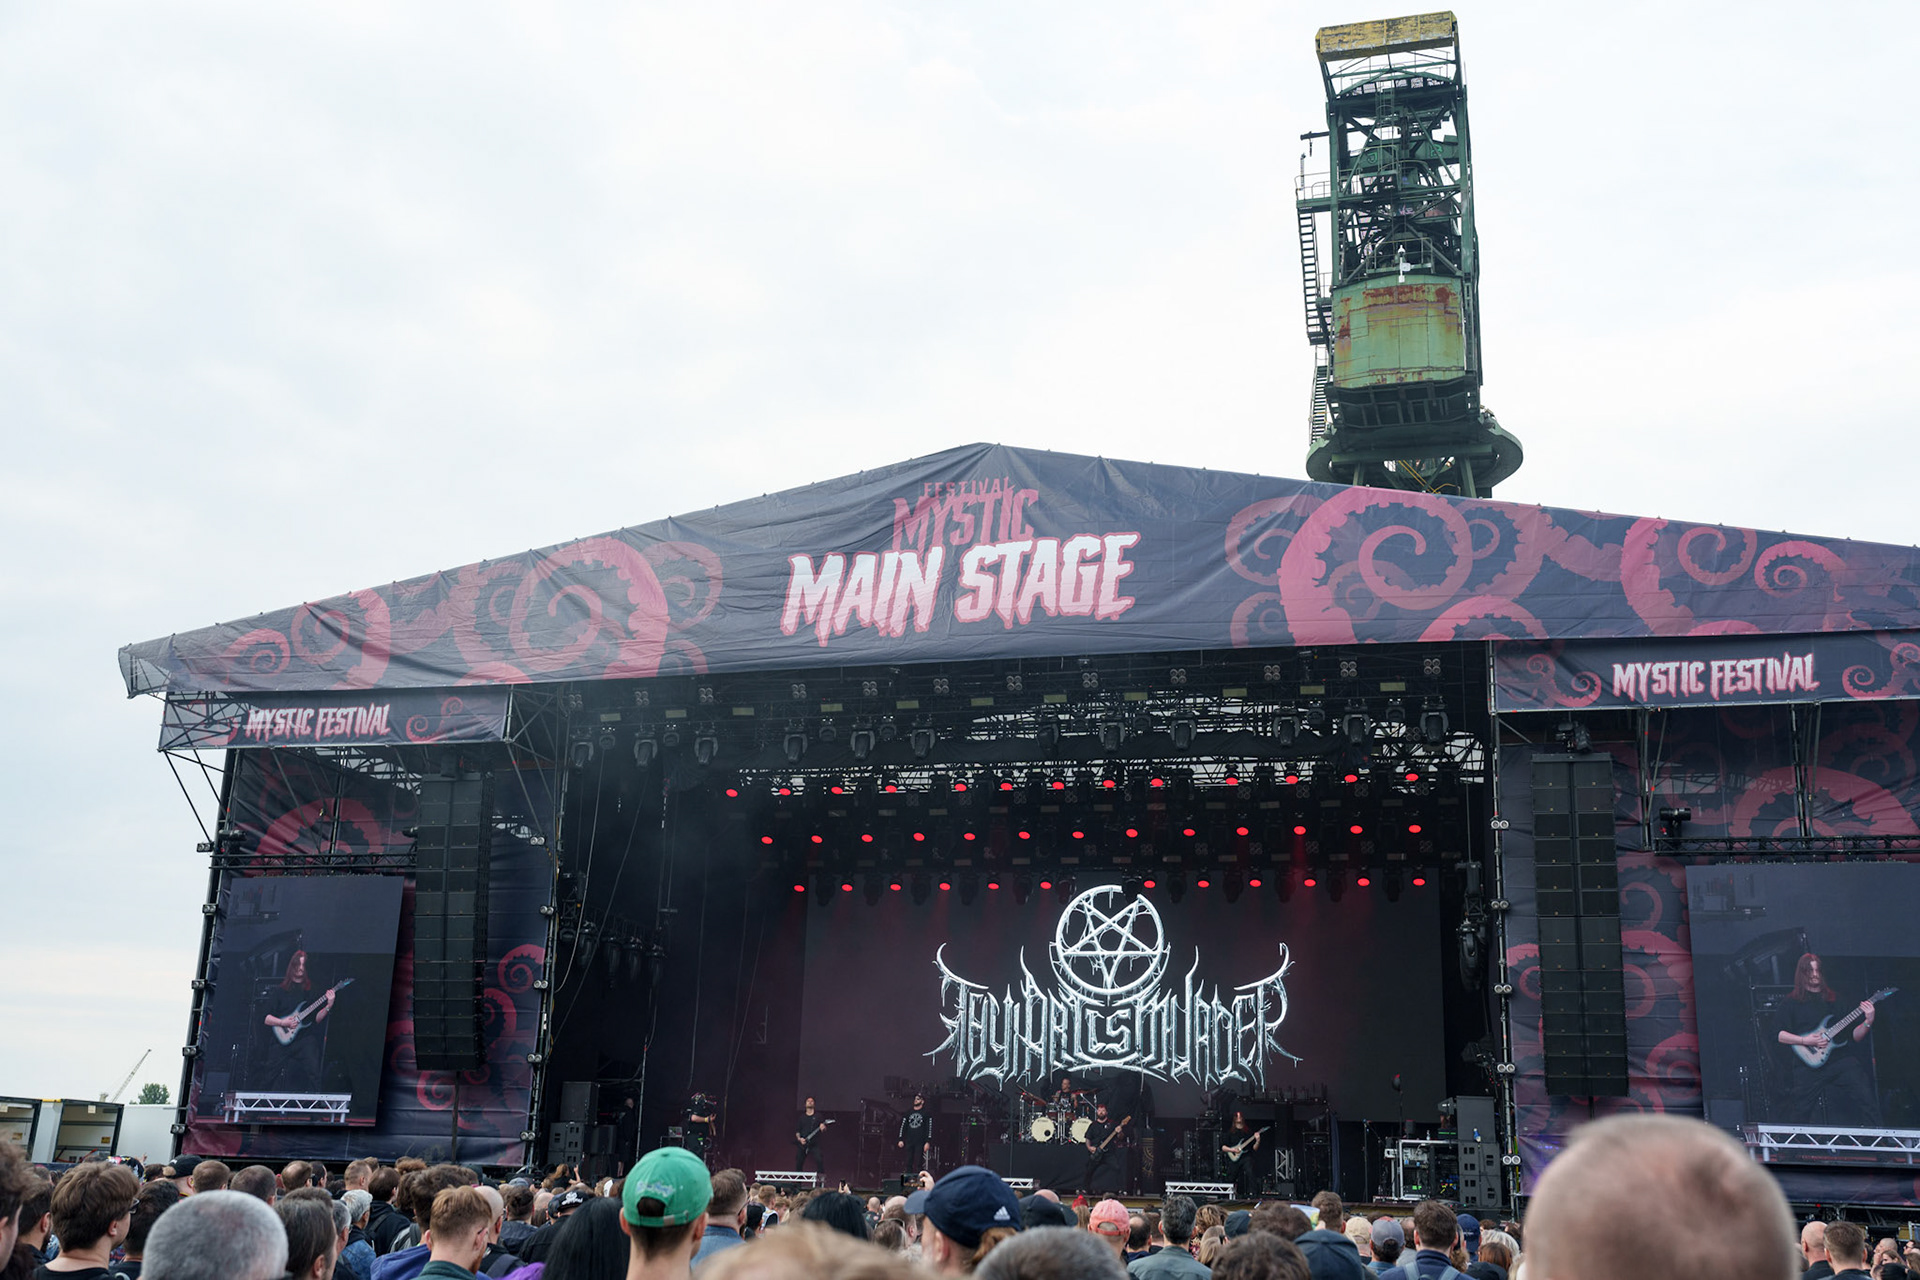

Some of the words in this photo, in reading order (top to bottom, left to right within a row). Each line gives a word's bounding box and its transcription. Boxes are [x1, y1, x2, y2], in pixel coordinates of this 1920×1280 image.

[924, 477, 1016, 498] FESTIVAL
[892, 488, 1039, 554] MYSTIC
[780, 546, 945, 648] MAIN
[954, 532, 1141, 629] STAGE
[1612, 661, 1705, 701] MYSTIC
[1709, 652, 1820, 701] FESTIVAL
[245, 708, 312, 742] MYSTIC
[315, 703, 391, 742] FESTIVAL
